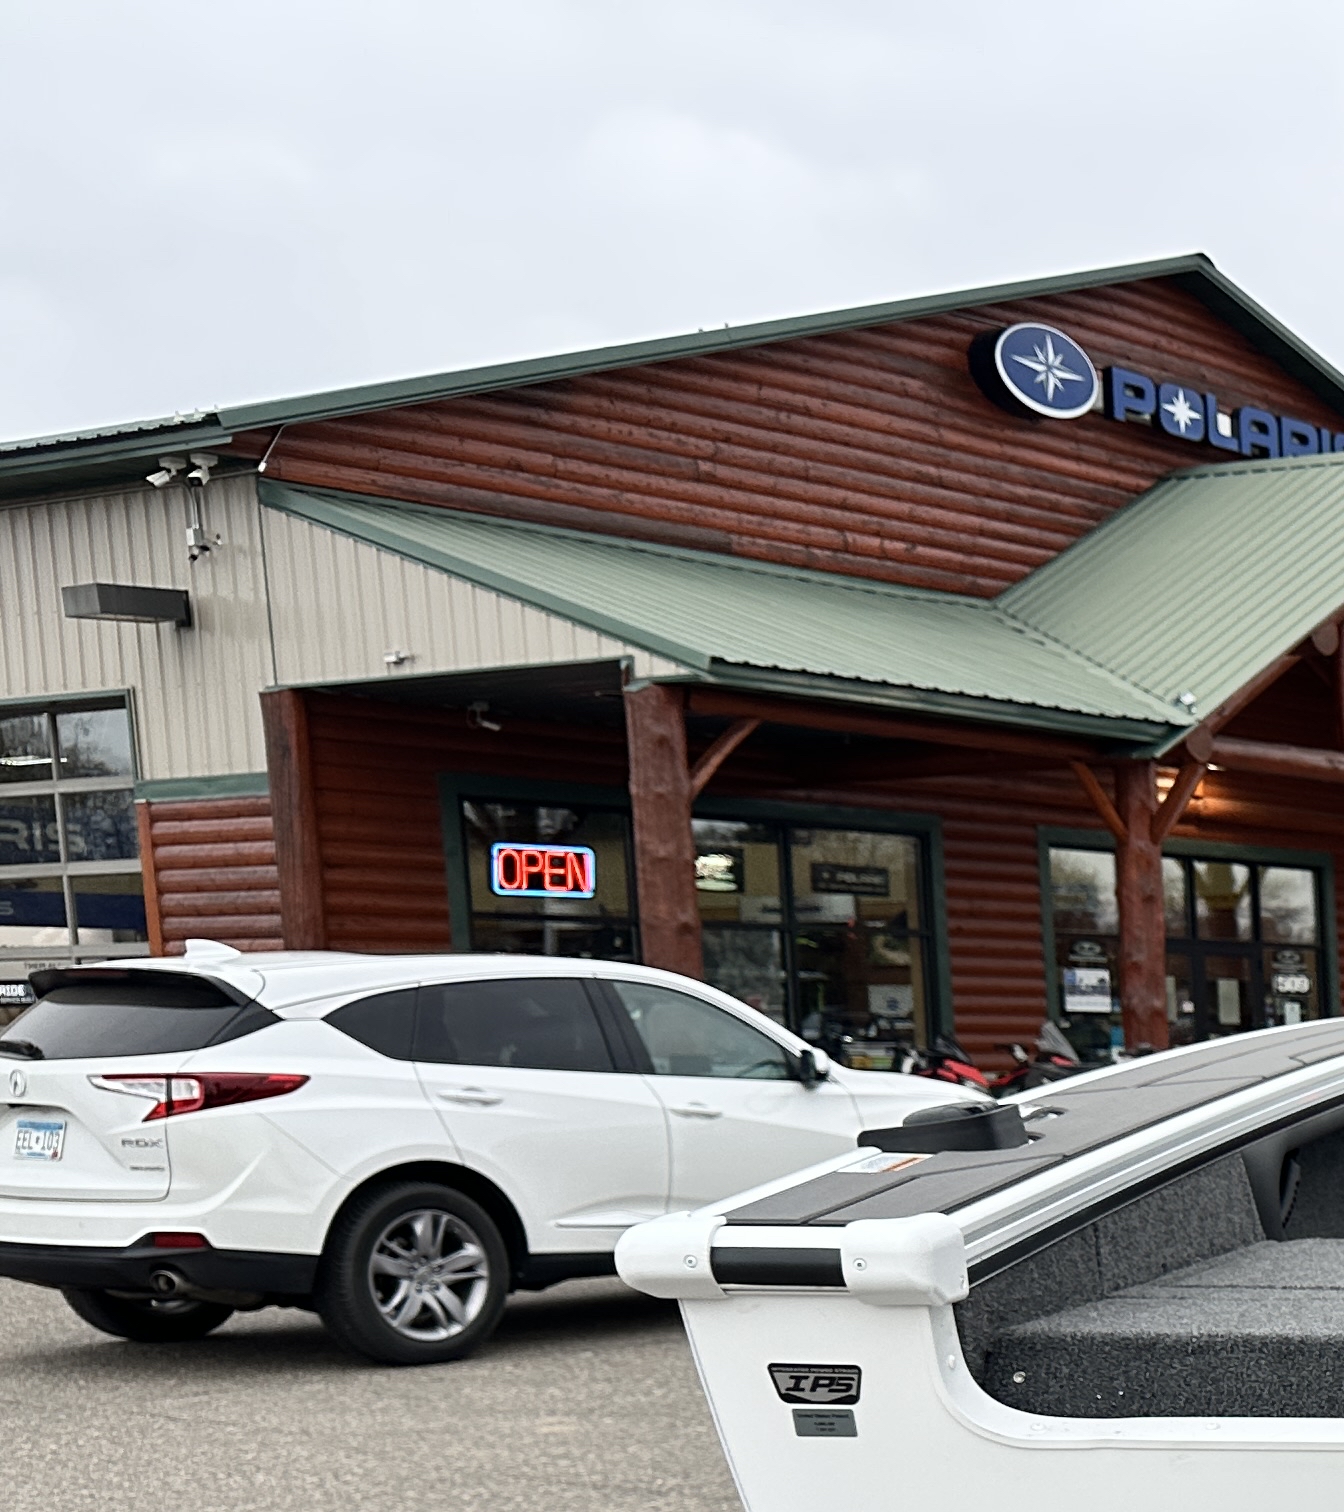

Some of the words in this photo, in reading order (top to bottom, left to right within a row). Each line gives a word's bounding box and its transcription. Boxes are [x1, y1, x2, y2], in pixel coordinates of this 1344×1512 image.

[497, 848, 591, 892] OPEN
[121, 1138, 163, 1148] RDX
[785, 1375, 856, 1393] IPS
